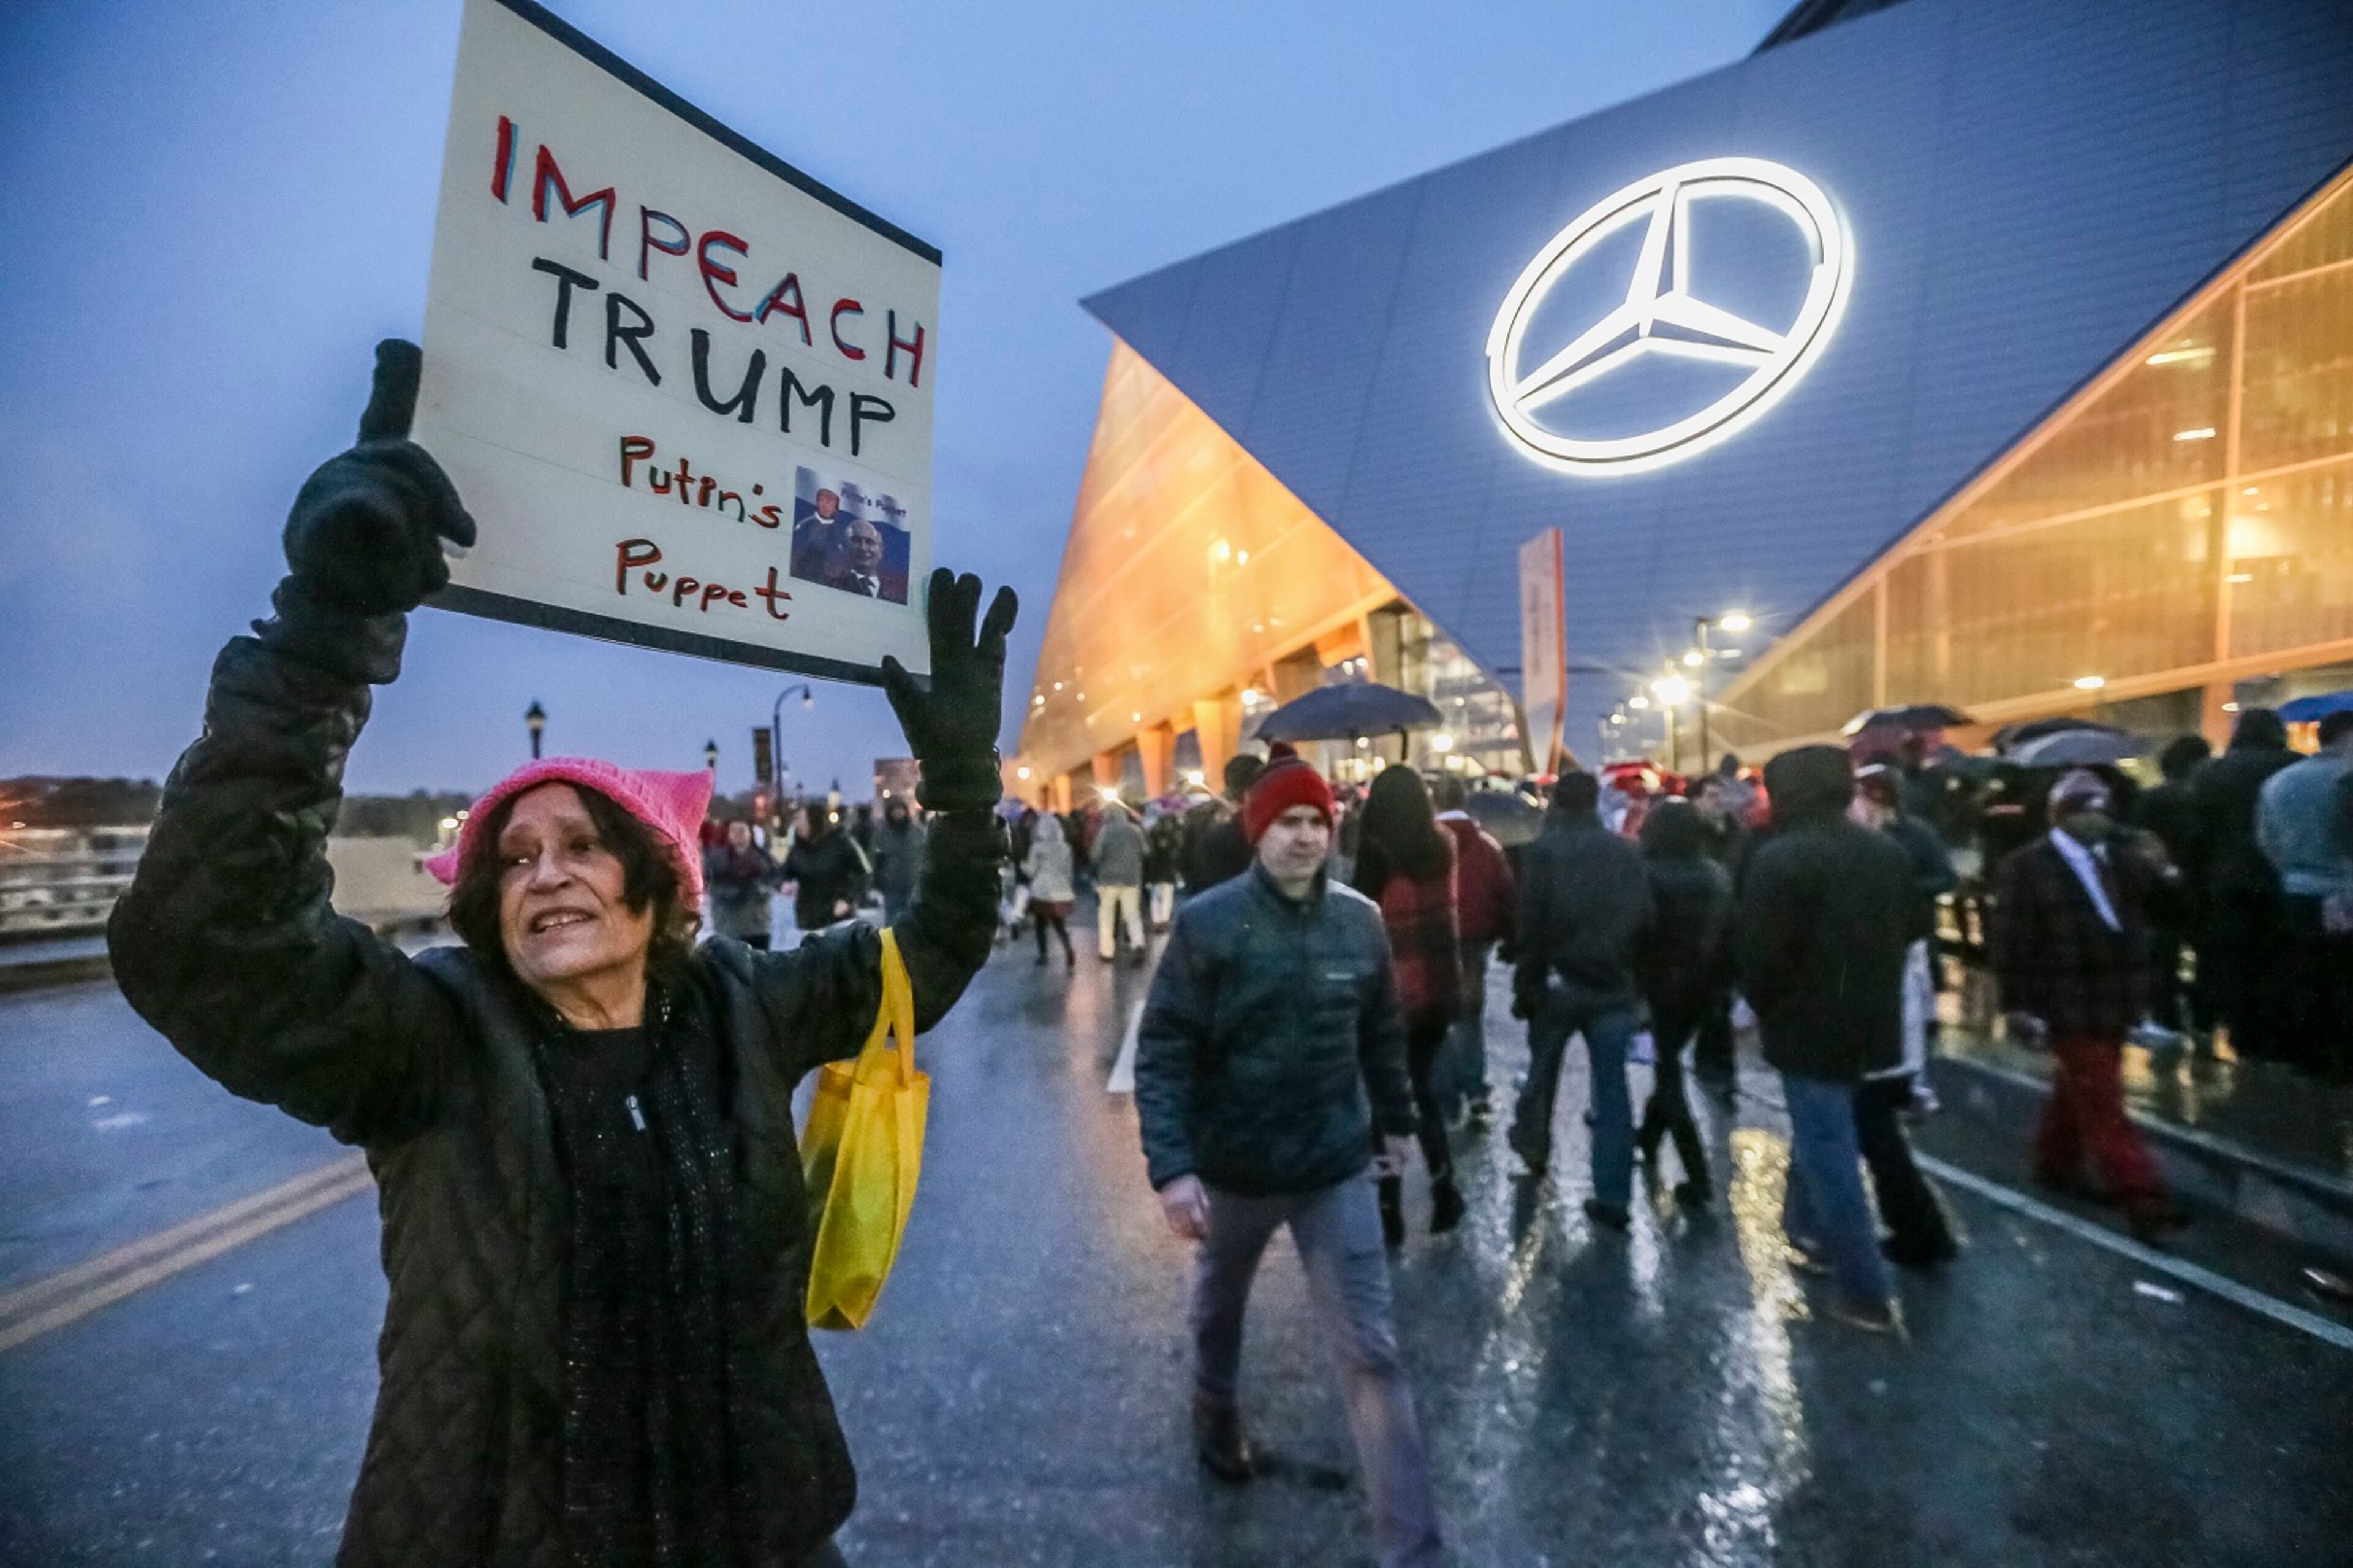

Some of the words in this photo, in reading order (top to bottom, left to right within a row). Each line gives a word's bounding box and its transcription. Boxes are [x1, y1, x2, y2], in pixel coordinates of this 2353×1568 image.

[491, 115, 925, 387] IMPEACH
[532, 257, 895, 456] TRUMP
[620, 436, 783, 528] Putin's
[616, 539, 793, 620] Puppet
